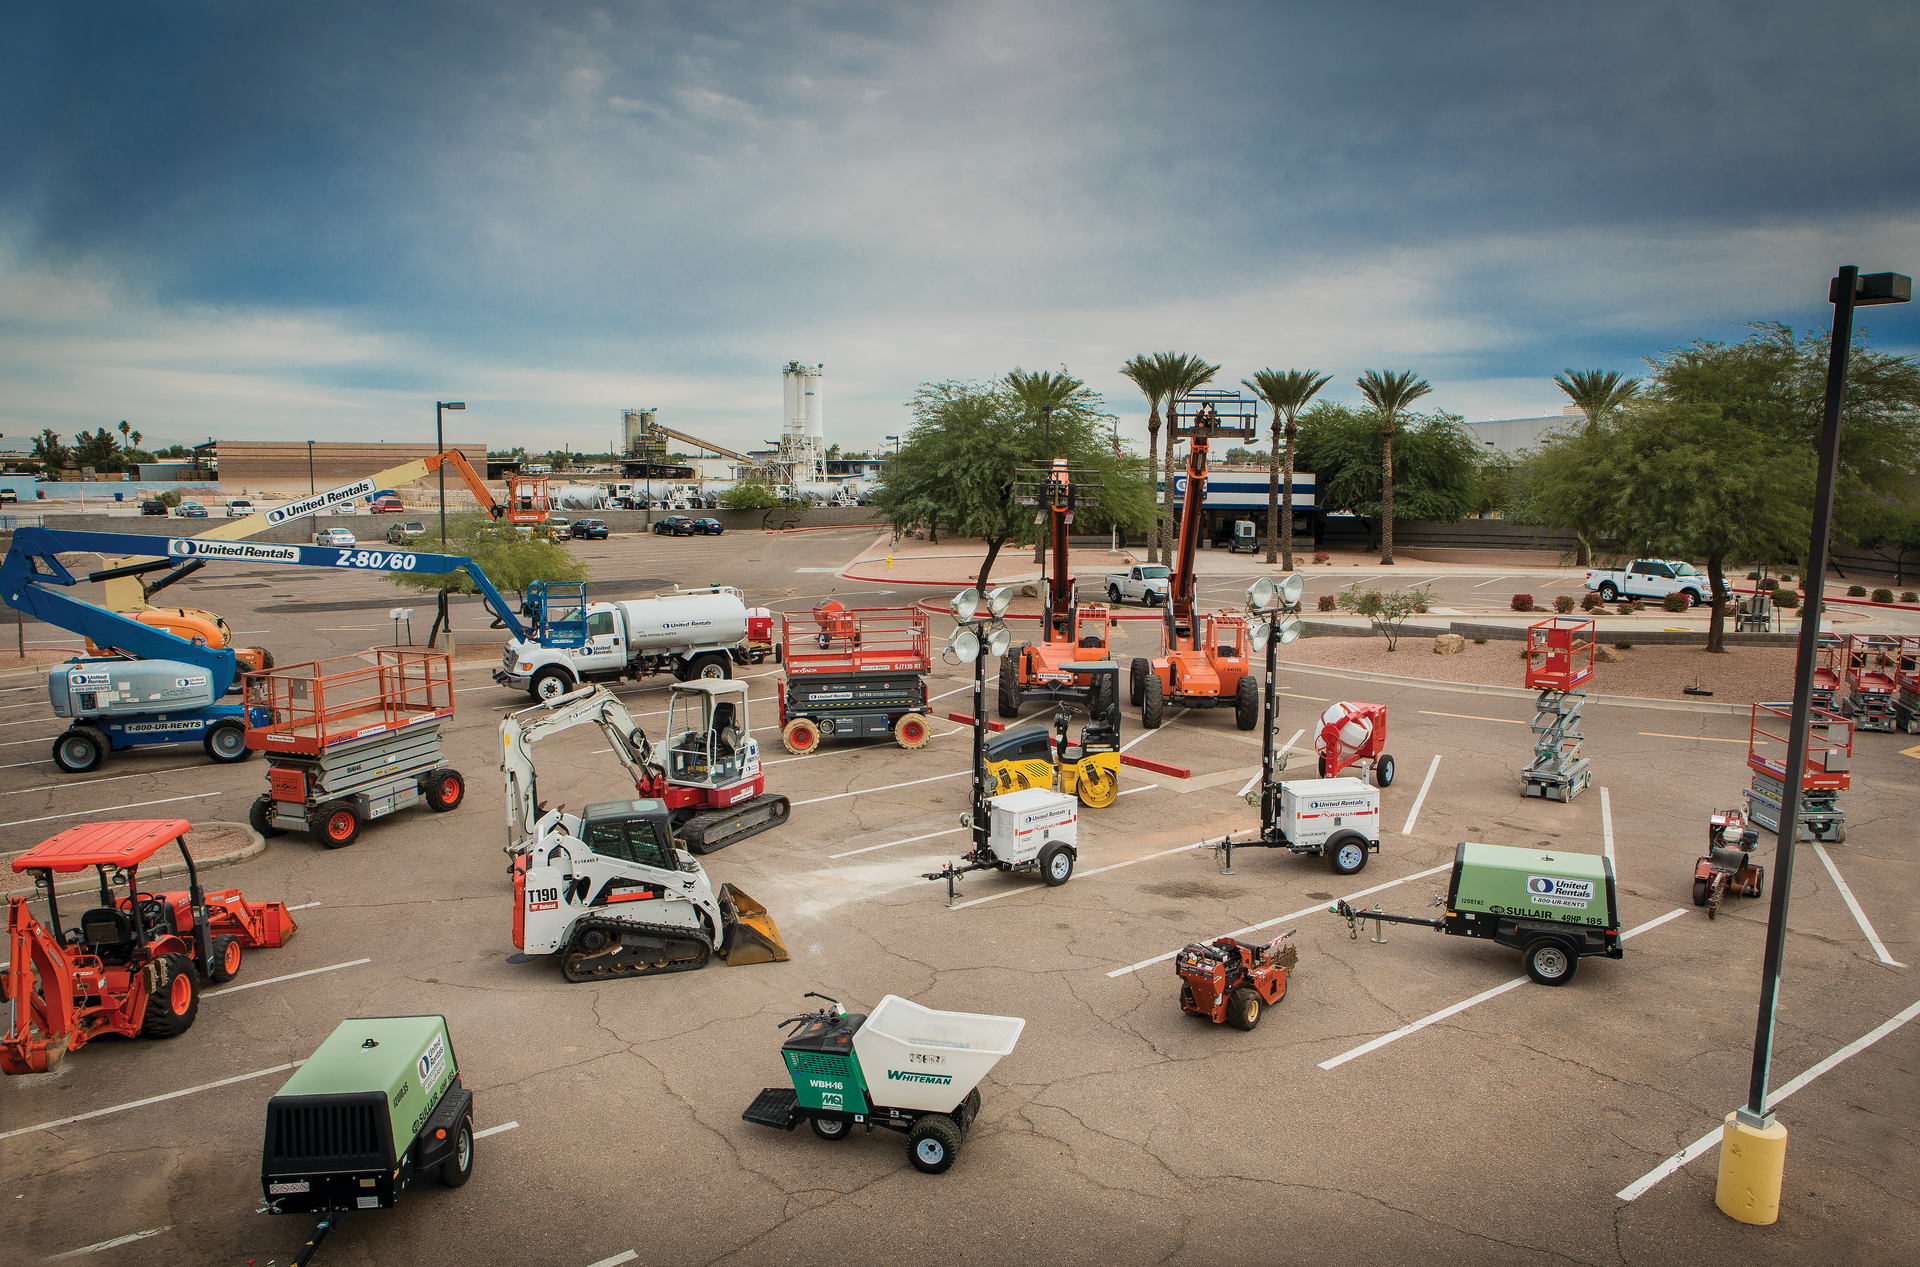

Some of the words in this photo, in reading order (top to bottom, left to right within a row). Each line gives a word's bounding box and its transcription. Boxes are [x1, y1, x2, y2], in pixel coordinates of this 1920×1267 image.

[286, 500, 325, 518] United
[328, 482, 370, 504] Rentals
[198, 543, 244, 557] United
[244, 546, 294, 560] Rentals
[336, 550, 416, 570] Z-80/60
[161, 688, 192, 698] Genie
[127, 721, 201, 732] 1-800-UR-RENTS
[1032, 812, 1048, 821] United
[1049, 809, 1065, 817] Rentals
[1556, 880, 1588, 890] United
[528, 887, 558, 903] T190
[1555, 888, 1590, 898] Rentals
[1533, 898, 1585, 907] 1-800-UR-RENTS
[1506, 907, 1553, 919] SULLAIR
[1561, 914, 1582, 923] 49HP
[428, 1036, 441, 1058] United
[430, 1046, 444, 1068] Rentals
[887, 1069, 952, 1085] WHITEMAN
[810, 1079, 843, 1090] WBH-16
[823, 1094, 843, 1105] MQ
[419, 1092, 438, 1125] SULLAIR
